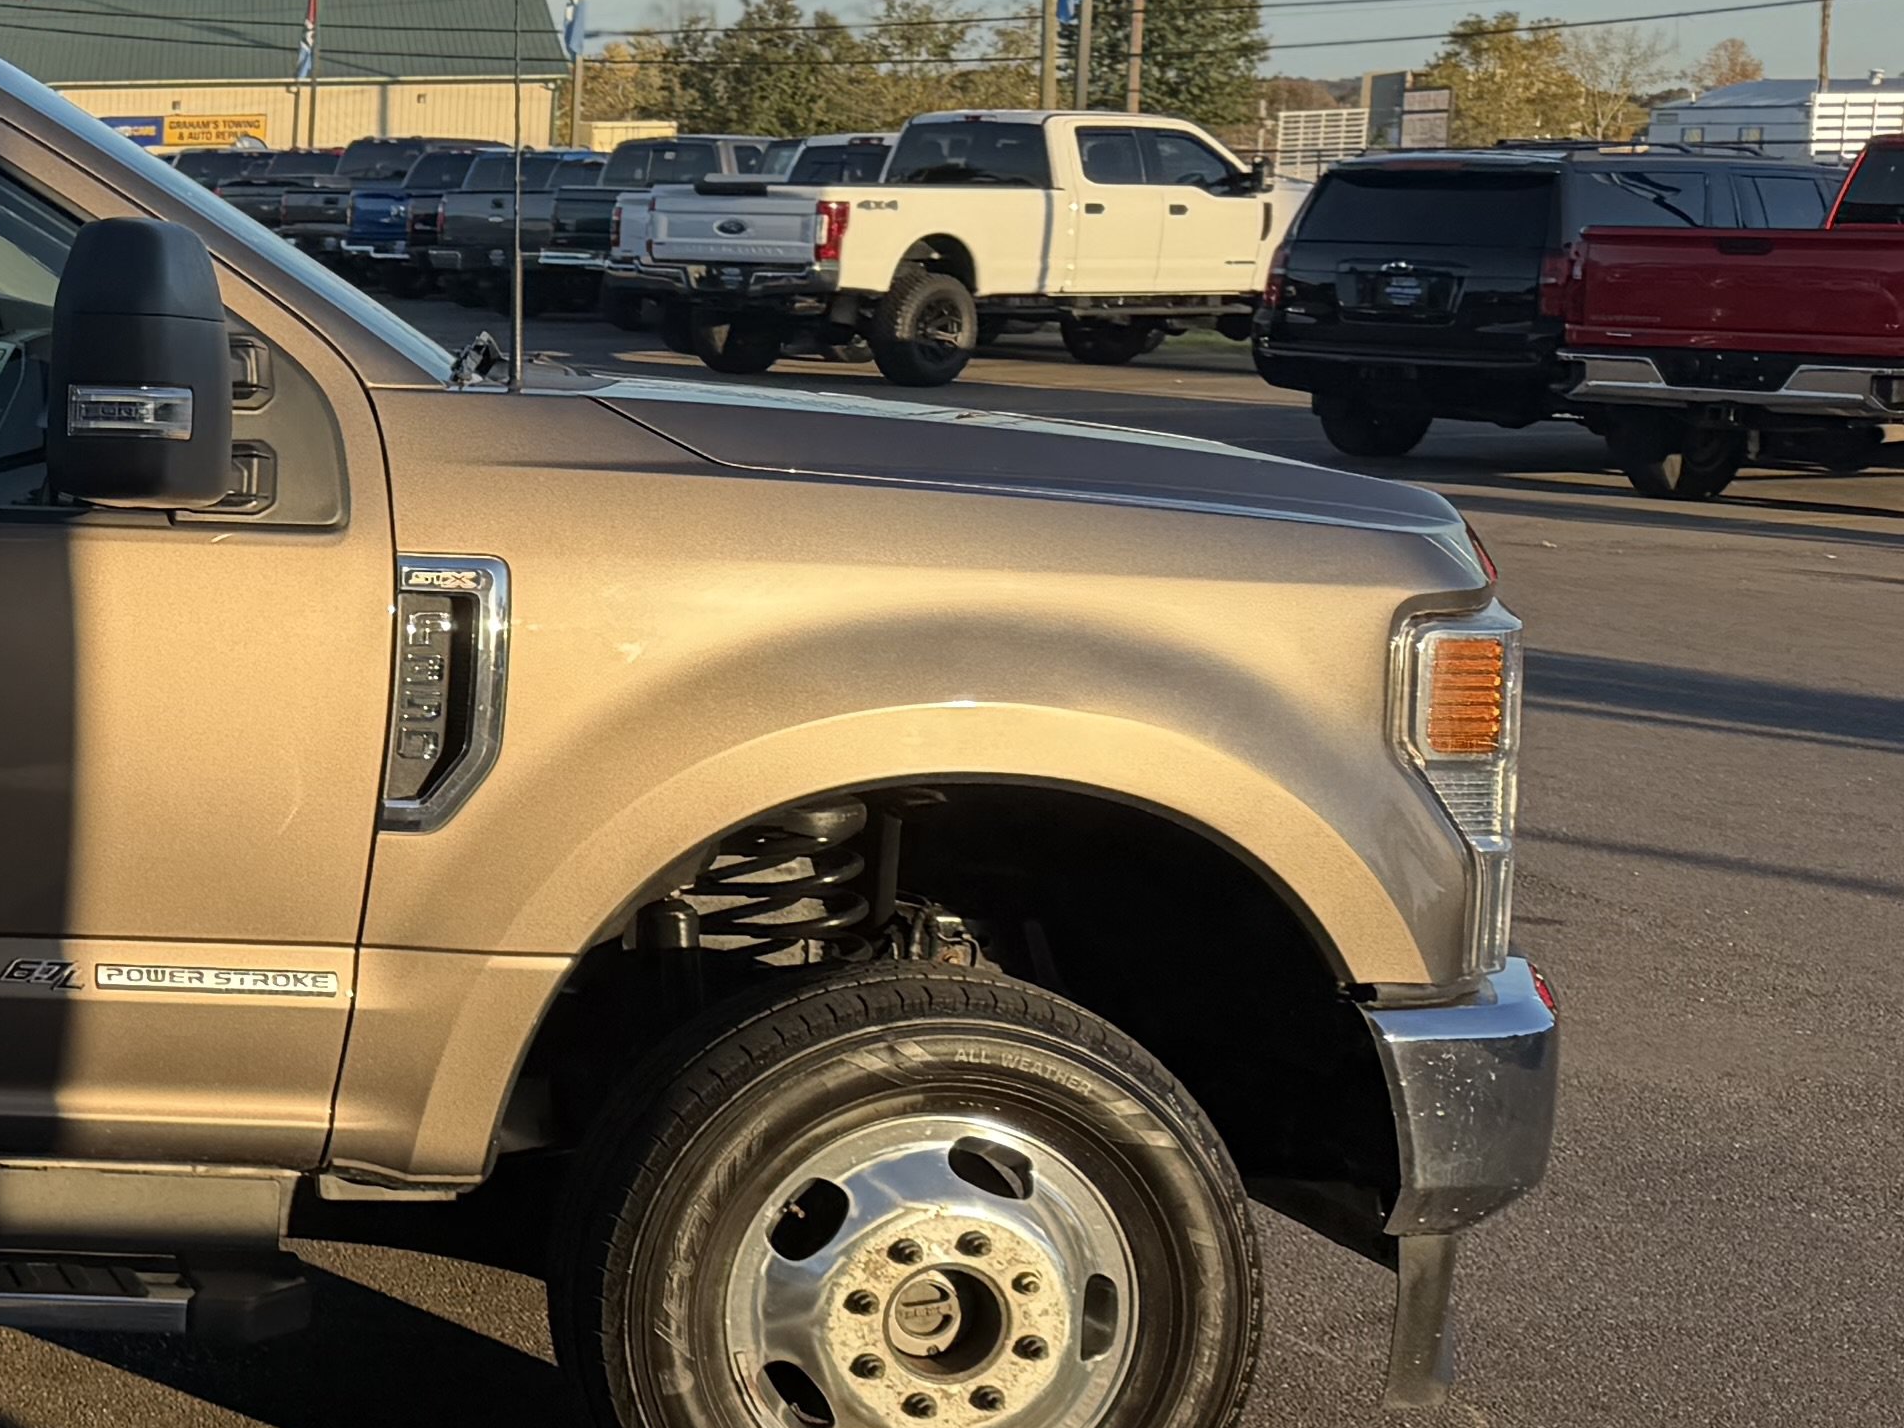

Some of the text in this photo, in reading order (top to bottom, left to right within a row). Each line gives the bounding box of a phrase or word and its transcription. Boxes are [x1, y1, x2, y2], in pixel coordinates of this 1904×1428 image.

[223, 120, 261, 129] TOWING
[187, 131, 212, 140] AUTO
[106, 967, 205, 985] POWER
[214, 971, 330, 990] STROKE
[954, 1048, 1093, 1097] ALL WEATHER
